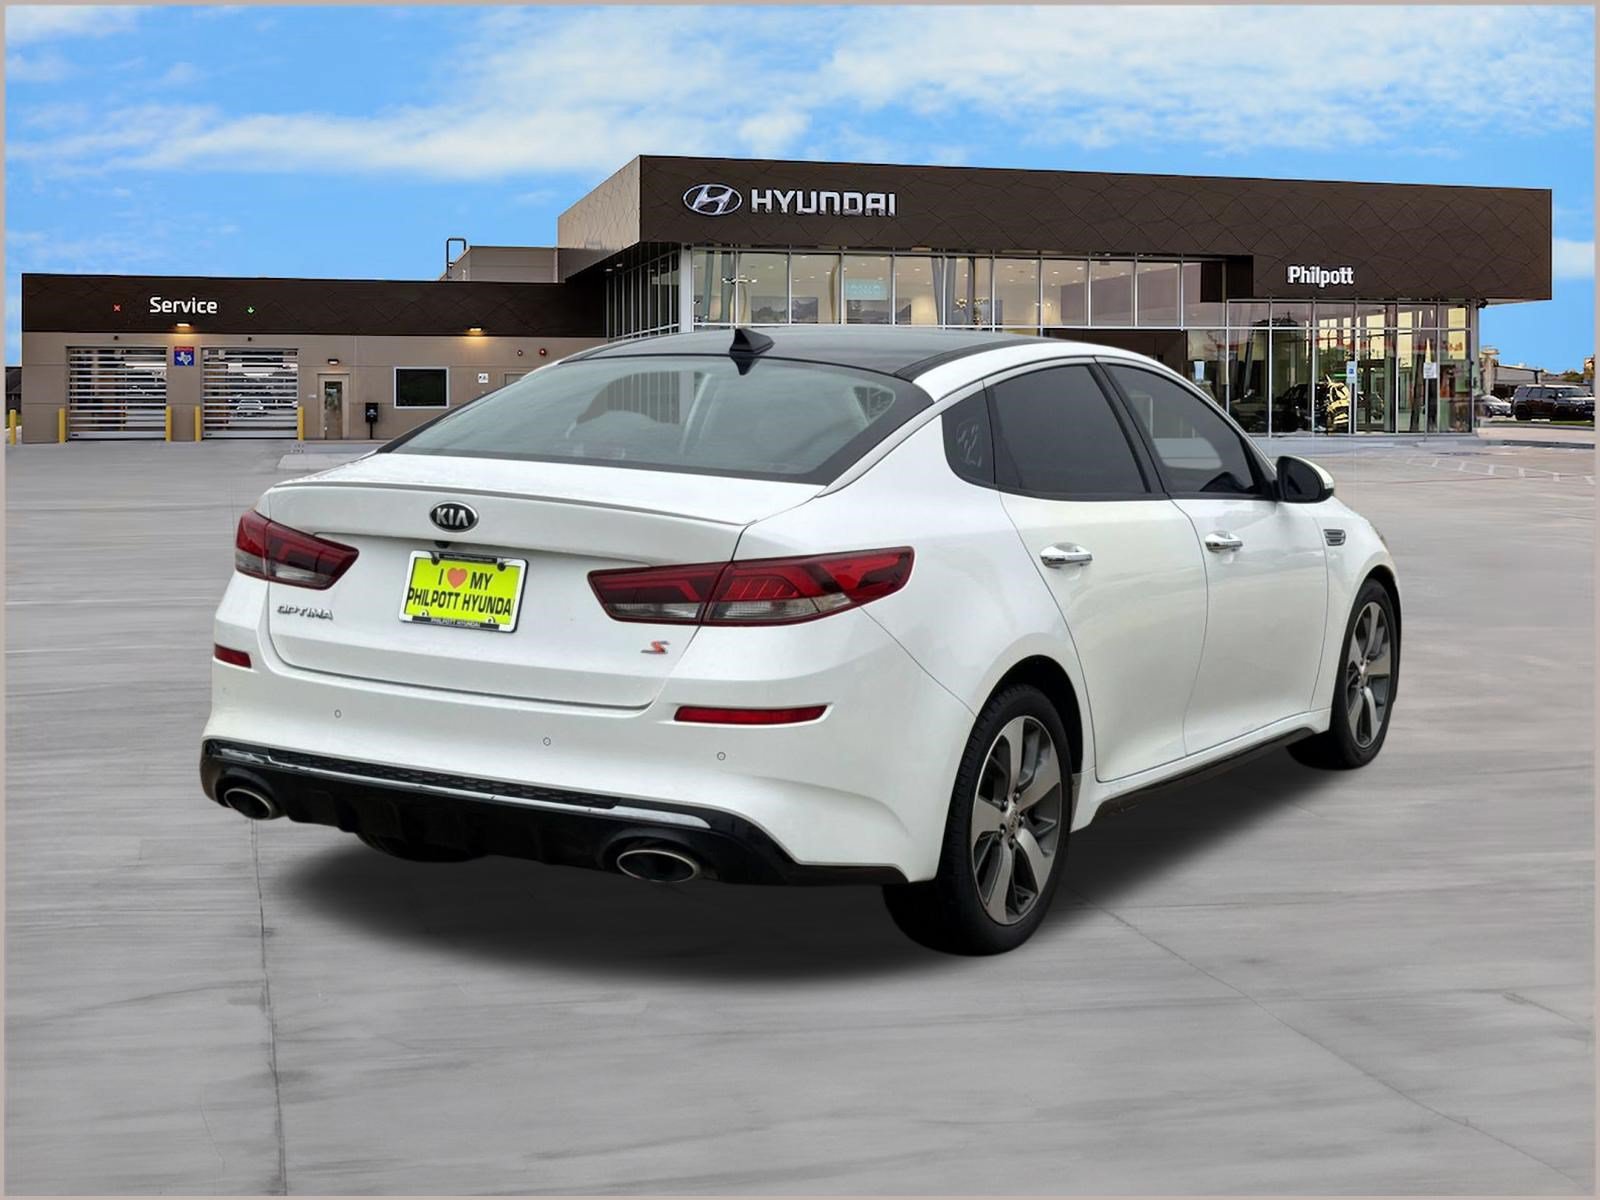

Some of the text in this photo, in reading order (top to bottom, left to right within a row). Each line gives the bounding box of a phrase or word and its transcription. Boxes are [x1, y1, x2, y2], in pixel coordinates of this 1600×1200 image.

[751, 189, 897, 216] HYUNDAI
[1287, 265, 1355, 288] Philpott
[149, 297, 218, 314] Service
[435, 507, 469, 527] KIA
[438, 569, 493, 591] I MY
[277, 604, 334, 621] OPTIMA
[407, 587, 515, 616] PHILPOTT HYUNDA
